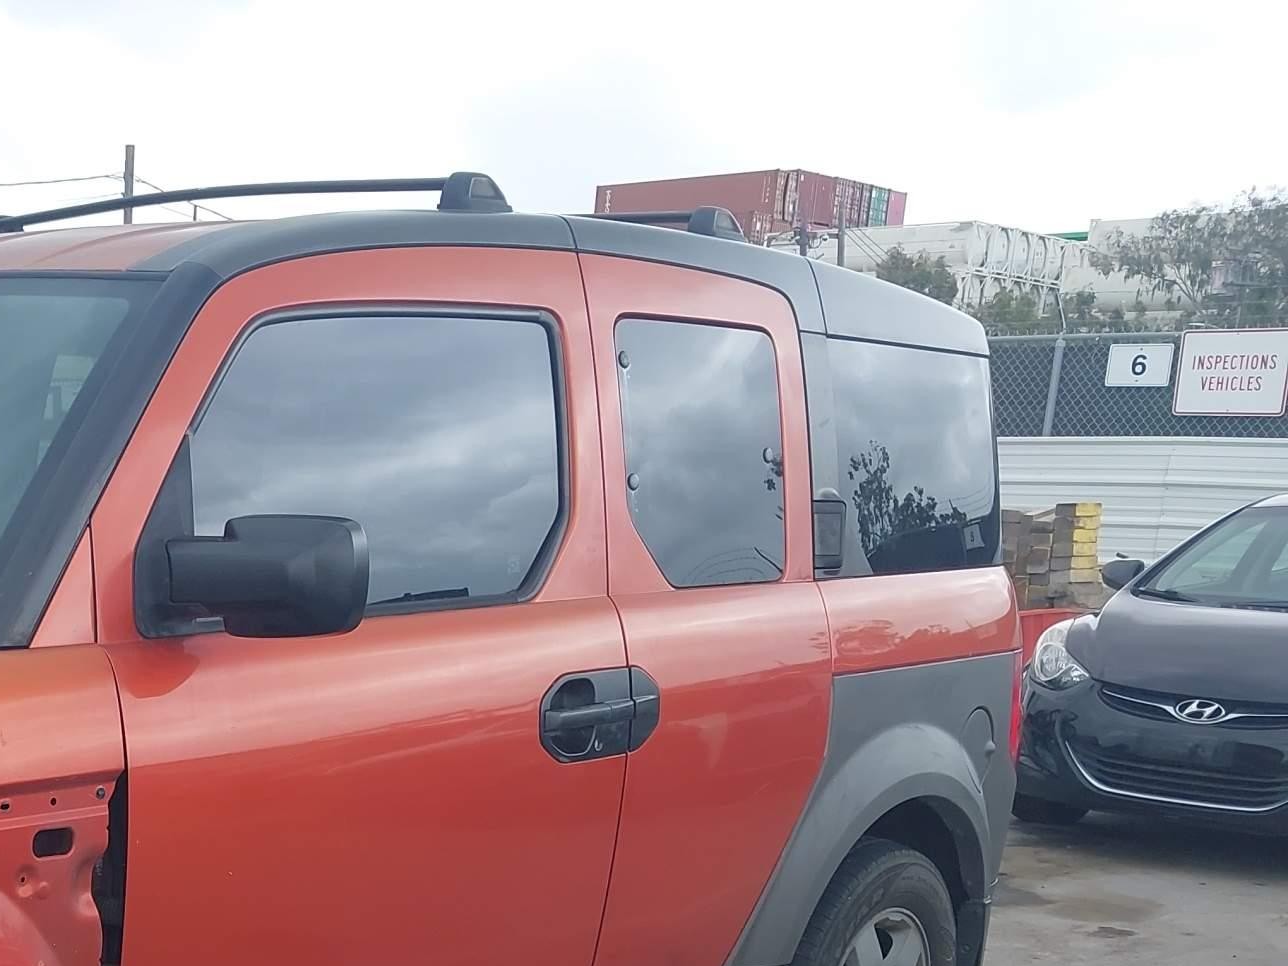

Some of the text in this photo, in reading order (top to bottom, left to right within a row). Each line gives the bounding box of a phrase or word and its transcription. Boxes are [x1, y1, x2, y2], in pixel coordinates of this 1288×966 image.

[1130, 354, 1148, 376] 6
[1192, 354, 1278, 370] INSPECTIONS
[1201, 376, 1263, 392] VEHICLES
